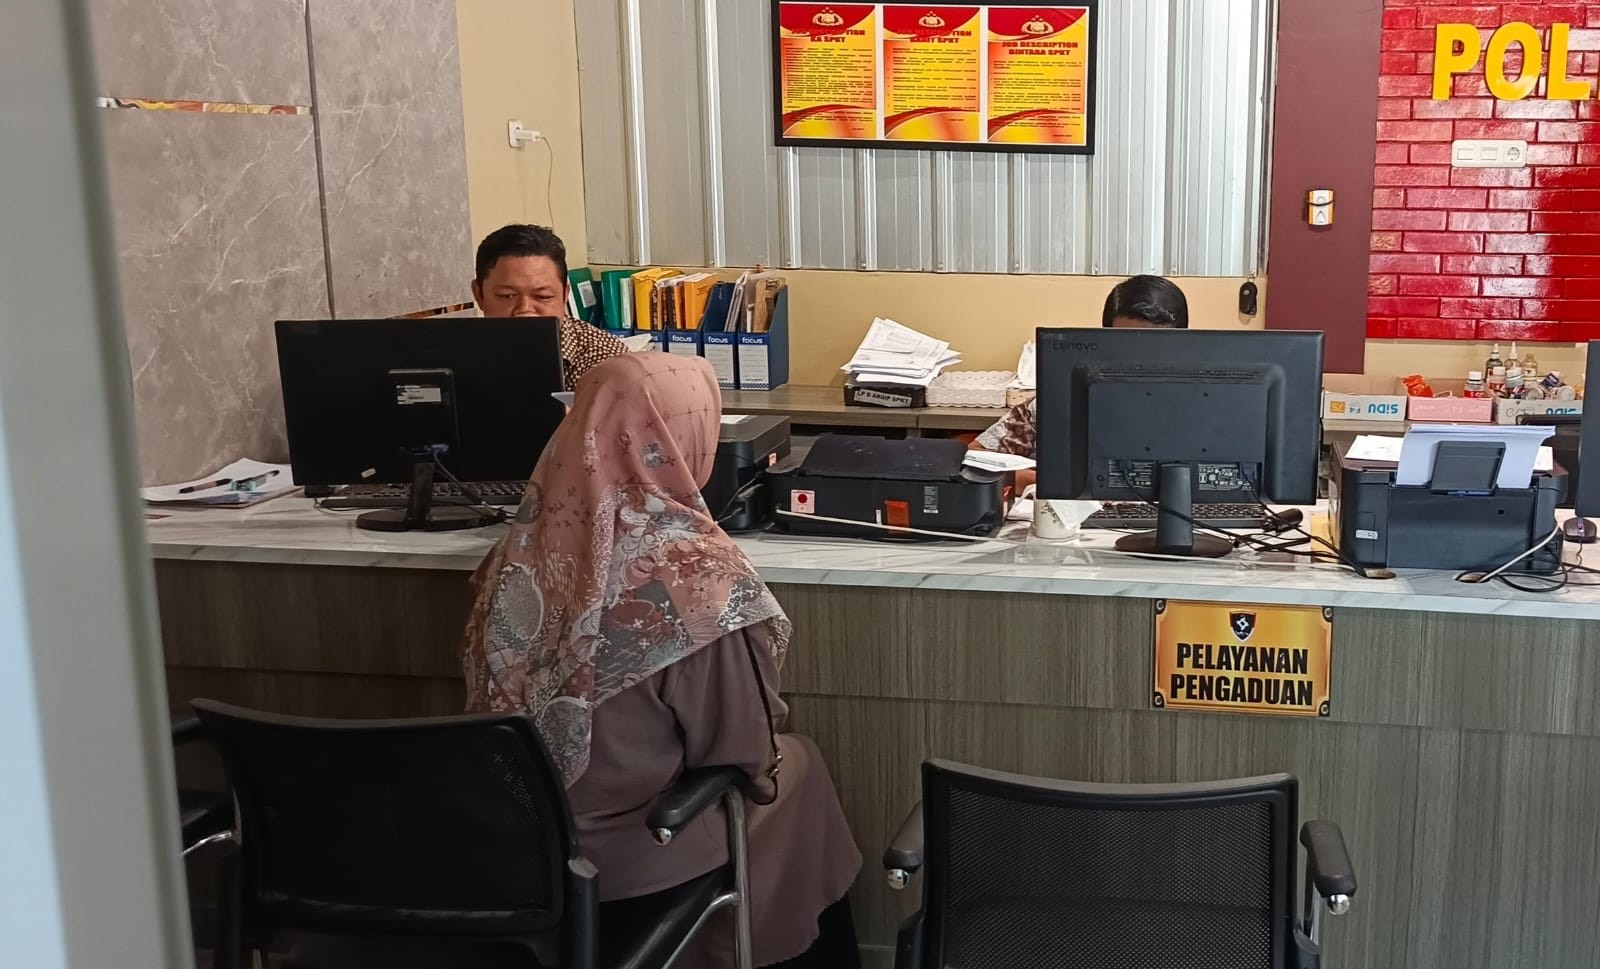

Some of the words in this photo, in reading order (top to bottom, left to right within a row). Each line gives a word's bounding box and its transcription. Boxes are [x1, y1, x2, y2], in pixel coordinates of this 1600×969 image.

[1432, 21, 1600, 100] POL
[672, 334, 692, 342] focus
[1176, 643, 1308, 674] PELAYANAN
[1170, 674, 1313, 706] PENGADUAN
